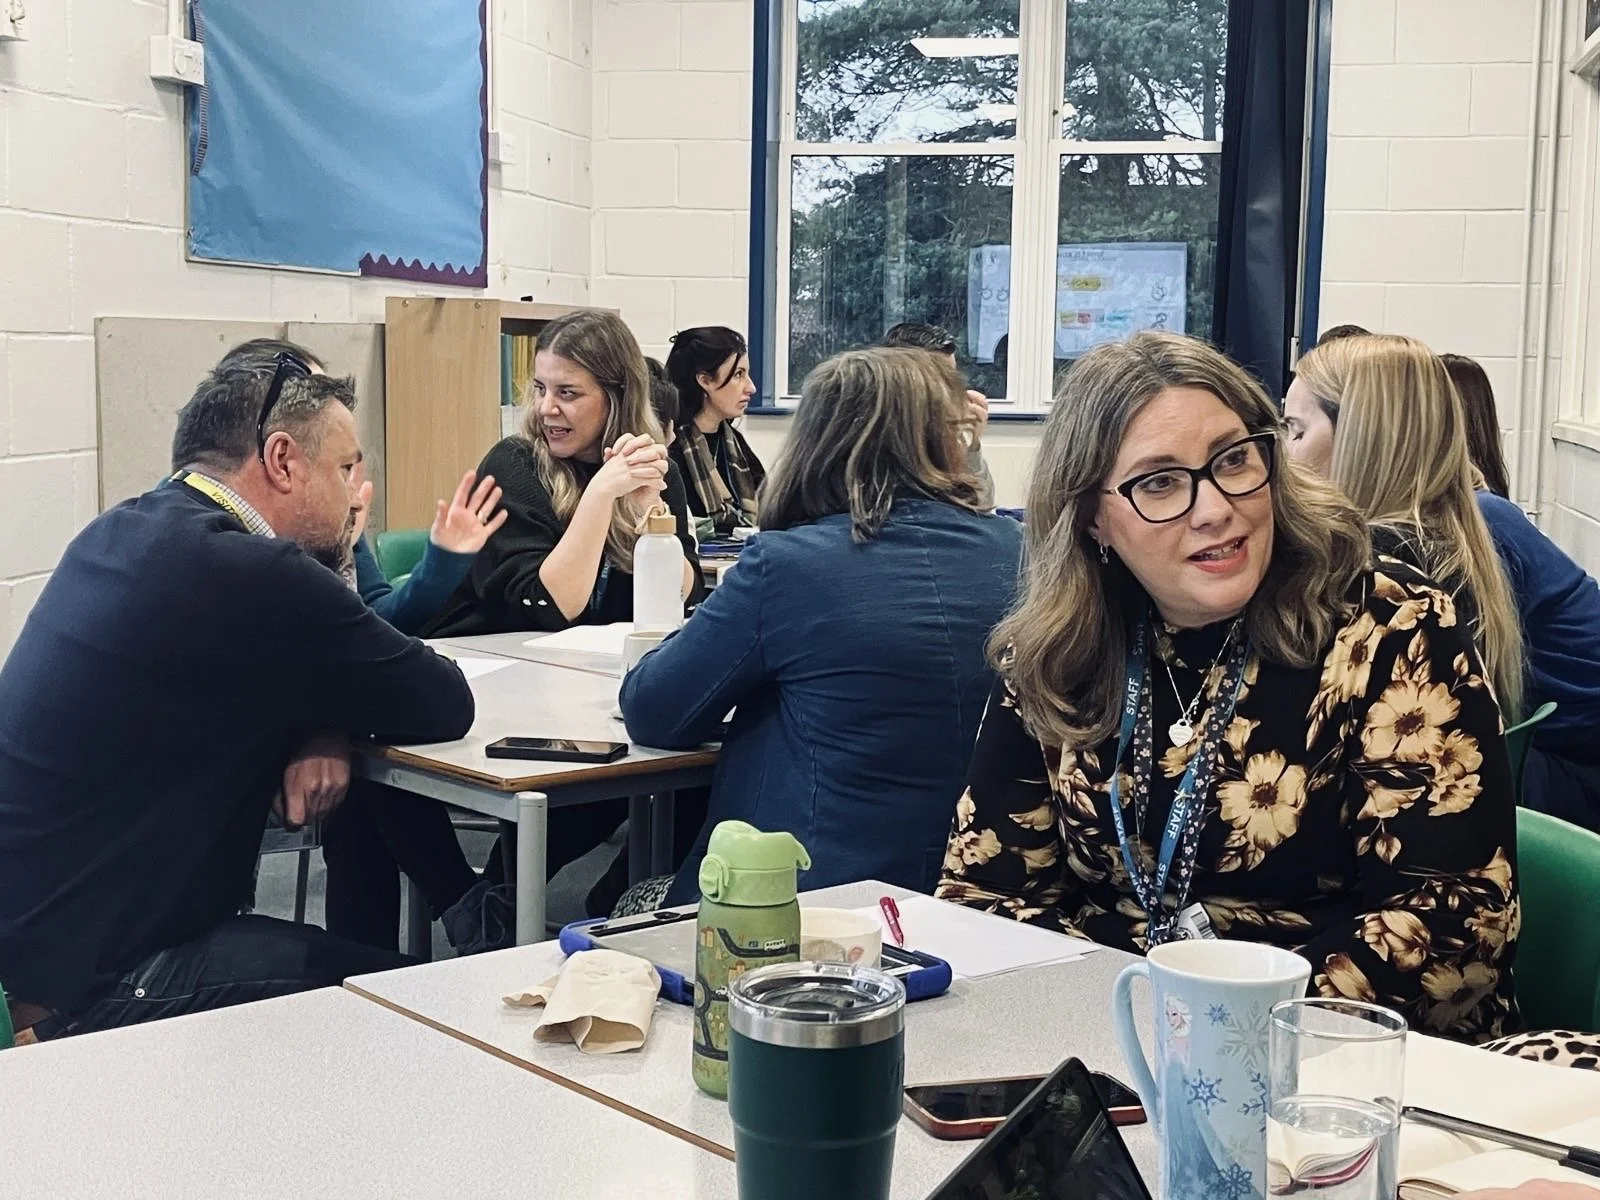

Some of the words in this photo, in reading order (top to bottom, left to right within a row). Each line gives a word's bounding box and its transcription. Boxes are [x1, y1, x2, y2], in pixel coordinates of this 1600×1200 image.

[212, 491, 242, 522] VISITO
[1126, 677, 1139, 715] STAFF
[1168, 800, 1185, 840] STAFF
[1155, 863, 1167, 890] STA
